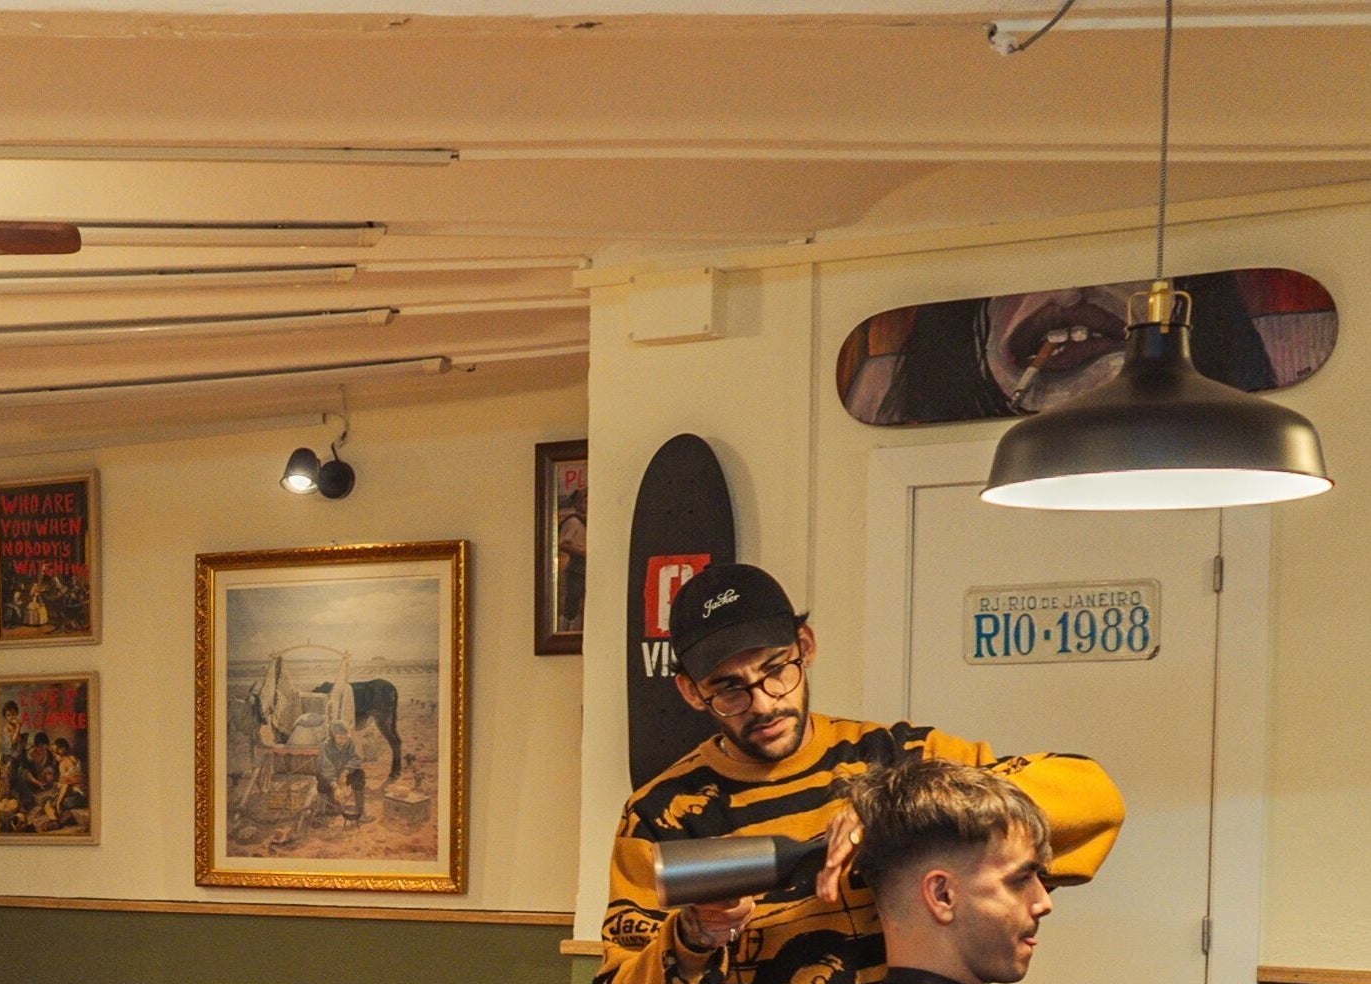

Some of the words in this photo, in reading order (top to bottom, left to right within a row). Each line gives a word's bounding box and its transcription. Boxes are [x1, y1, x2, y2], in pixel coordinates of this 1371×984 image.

[0, 493, 39, 515] WHO
[42, 492, 75, 514] ARE
[0, 519, 32, 538] YOU
[35, 516, 84, 536] WHEN
[1041, 597, 1058, 609] DE
[1063, 591, 1142, 609] JANEIRO
